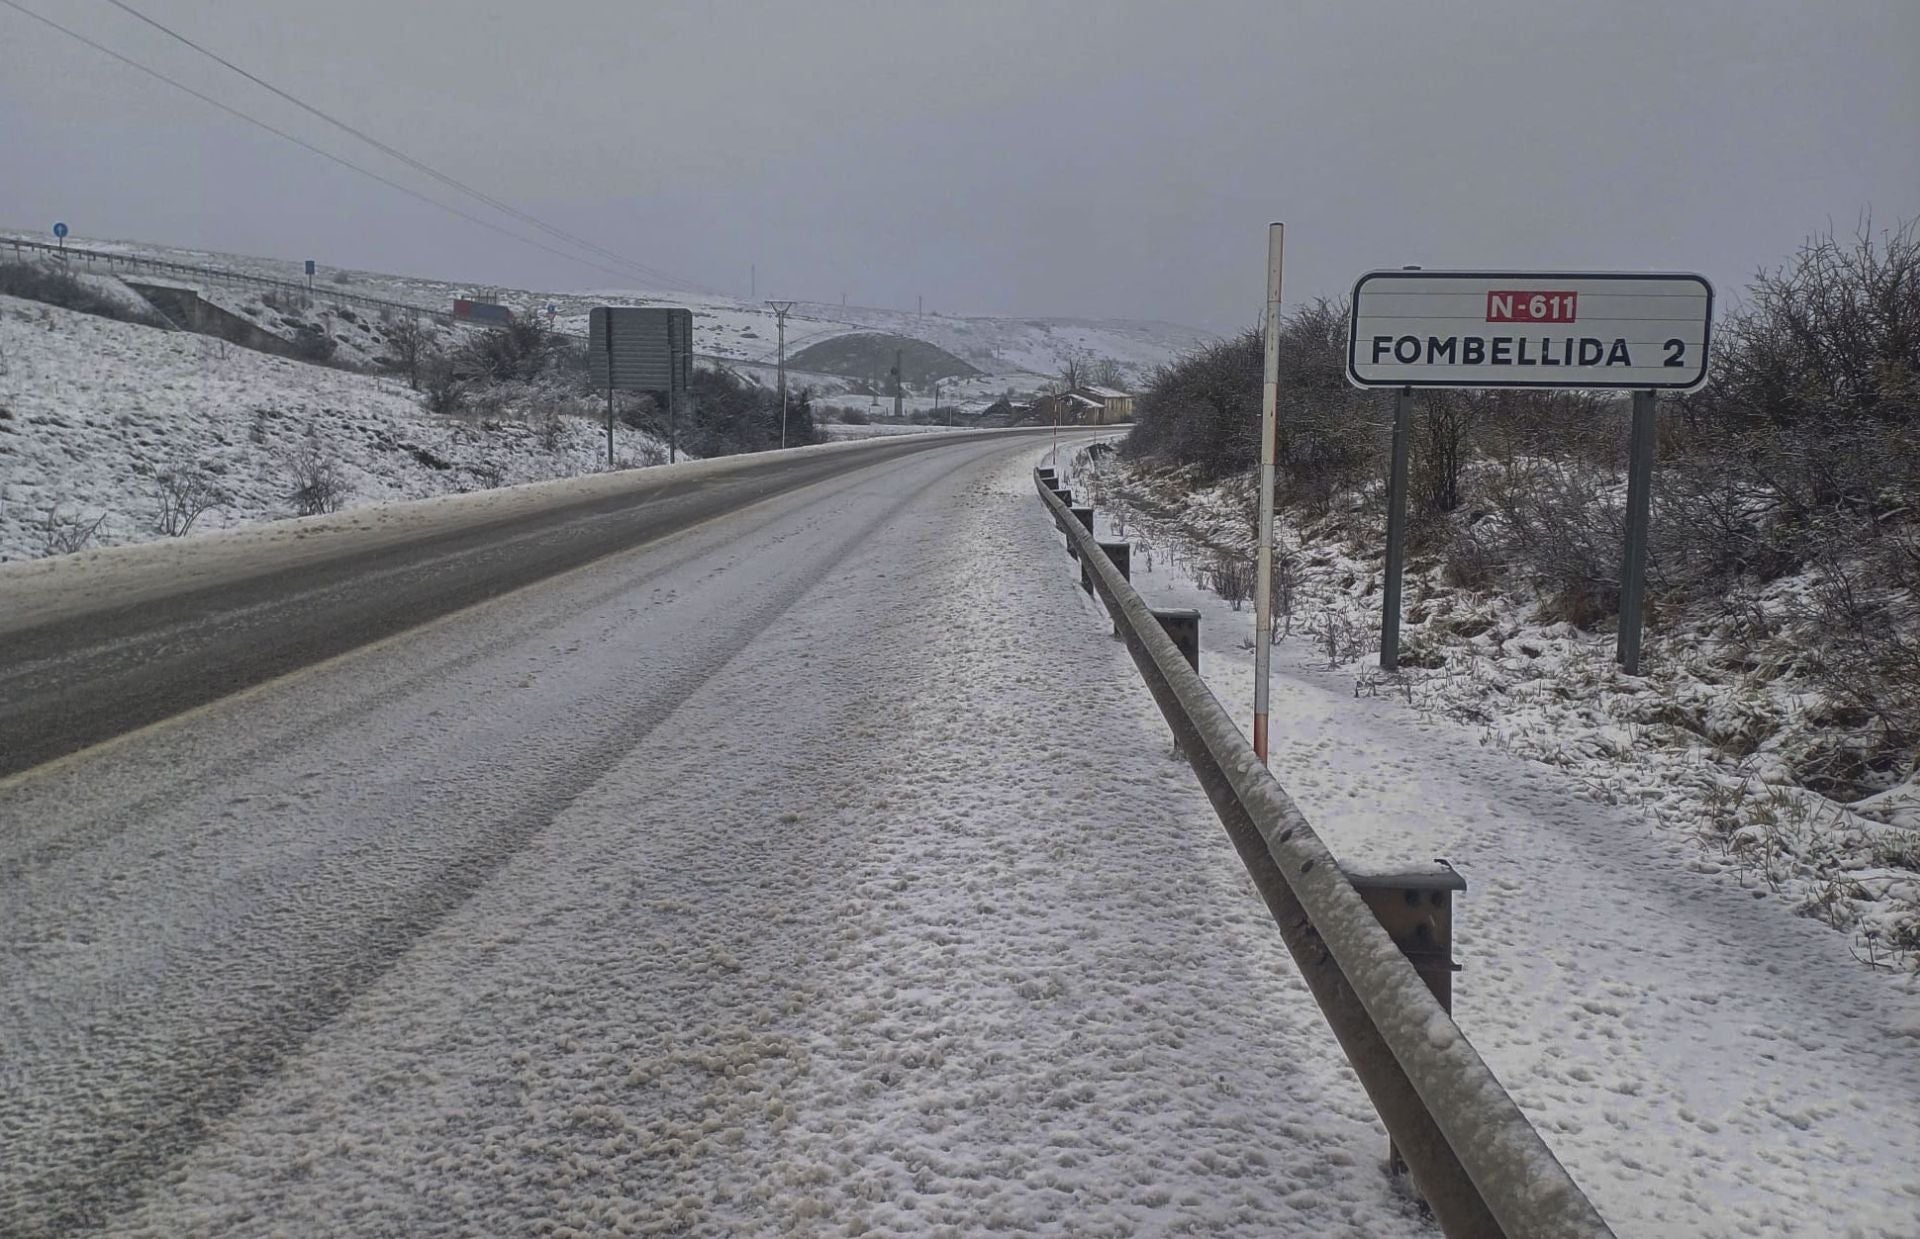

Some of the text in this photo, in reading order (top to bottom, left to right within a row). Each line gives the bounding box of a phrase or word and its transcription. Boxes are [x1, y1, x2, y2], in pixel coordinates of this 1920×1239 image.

[1491, 295, 1574, 319] N-611
[1372, 335, 1685, 367] FOMBELLIDA 2
